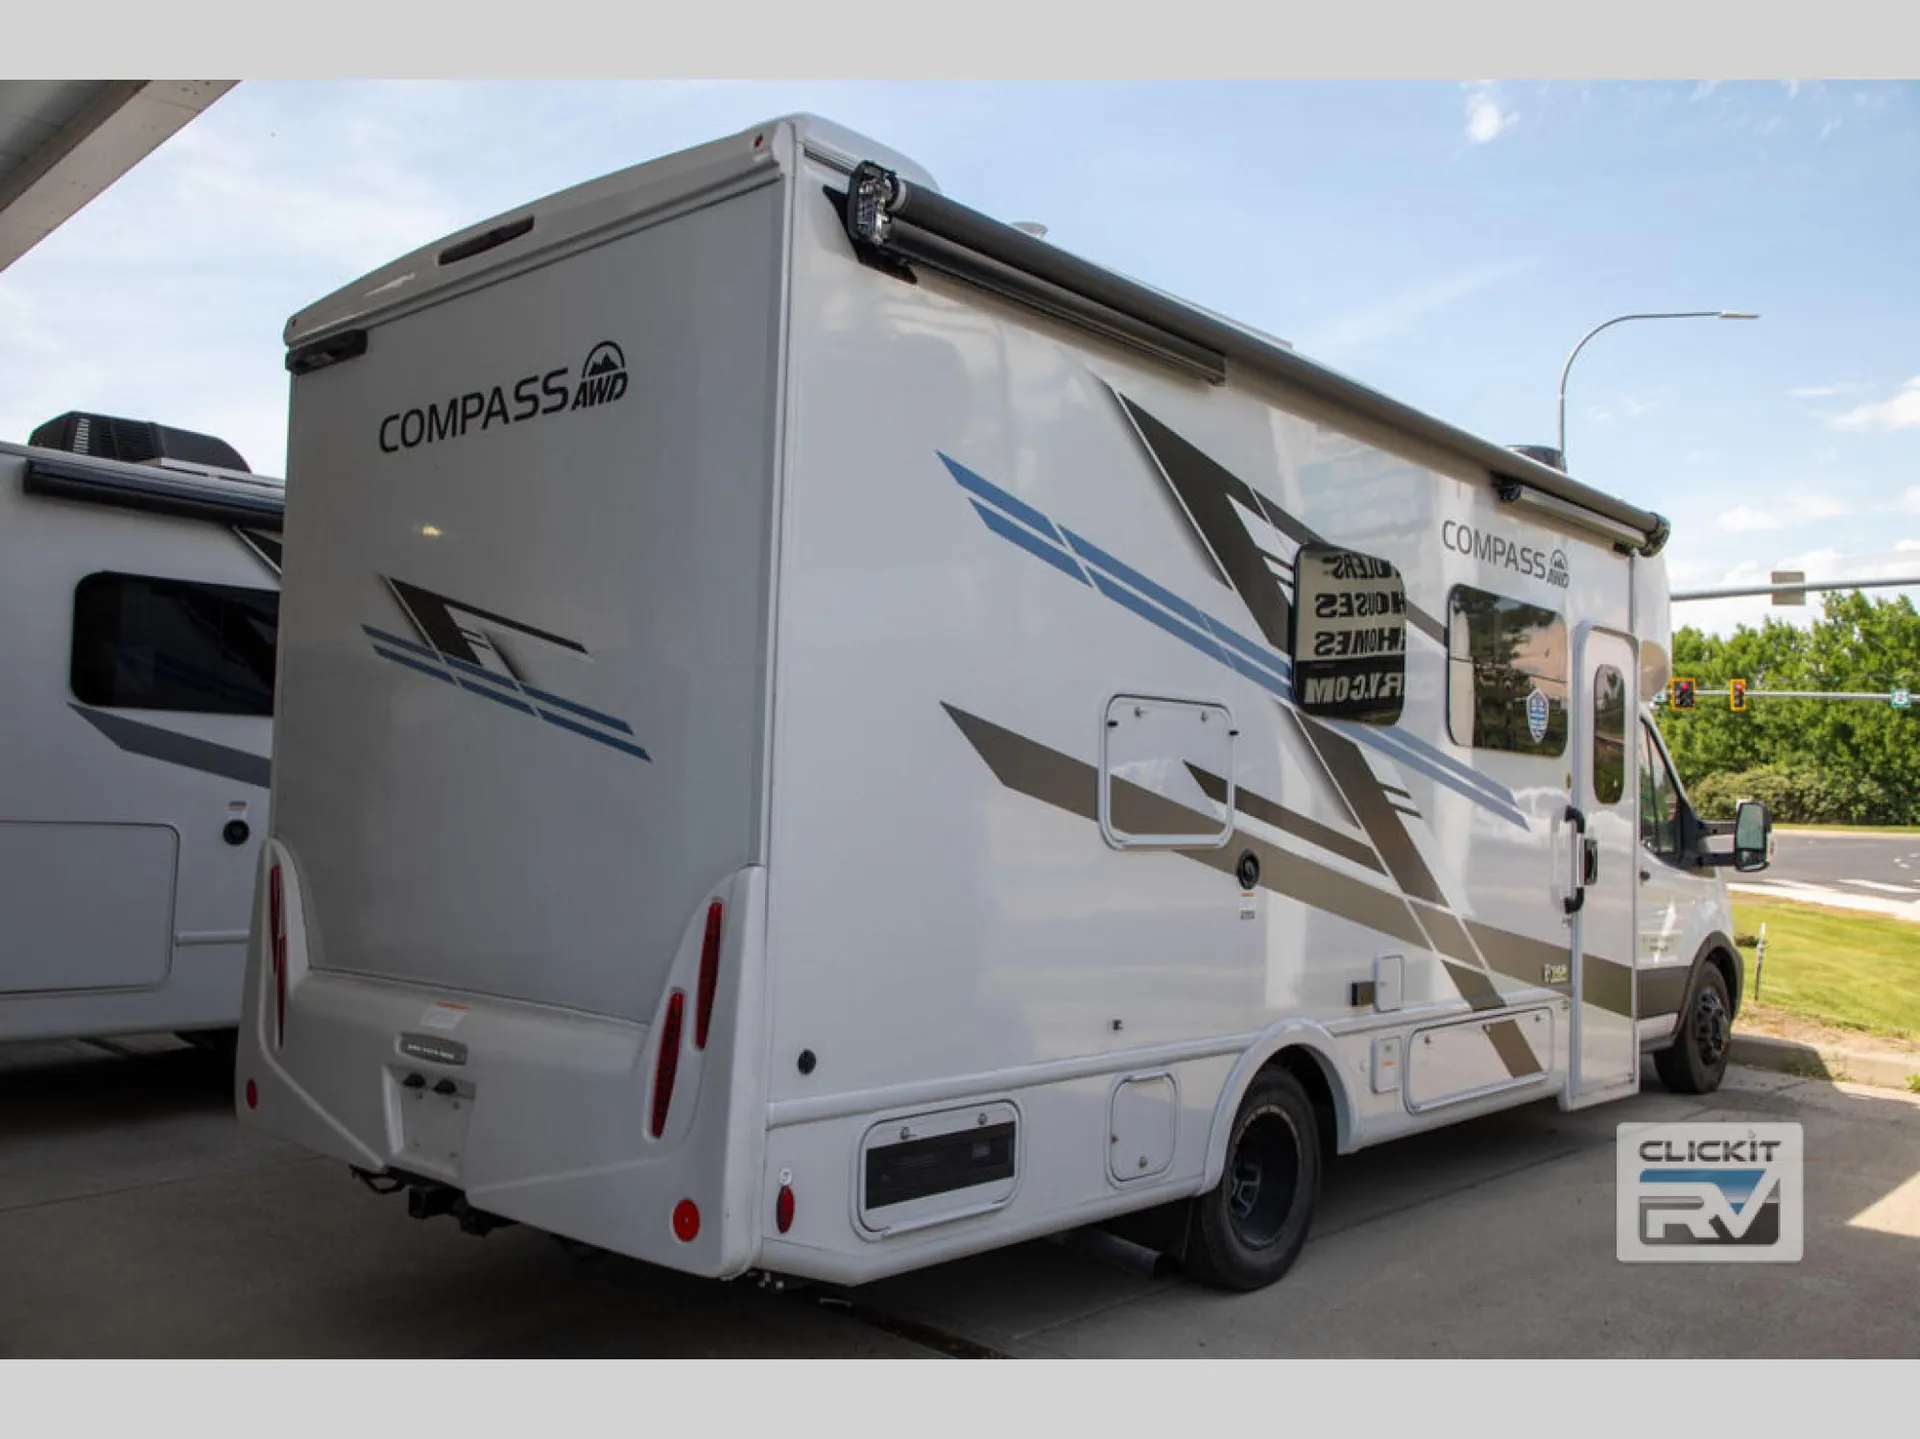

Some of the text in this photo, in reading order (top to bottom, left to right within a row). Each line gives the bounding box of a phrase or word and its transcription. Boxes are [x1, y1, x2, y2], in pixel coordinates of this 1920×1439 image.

[379, 367, 629, 453] COMPASS AWD
[1442, 519, 1571, 589] COMPASS AWD
